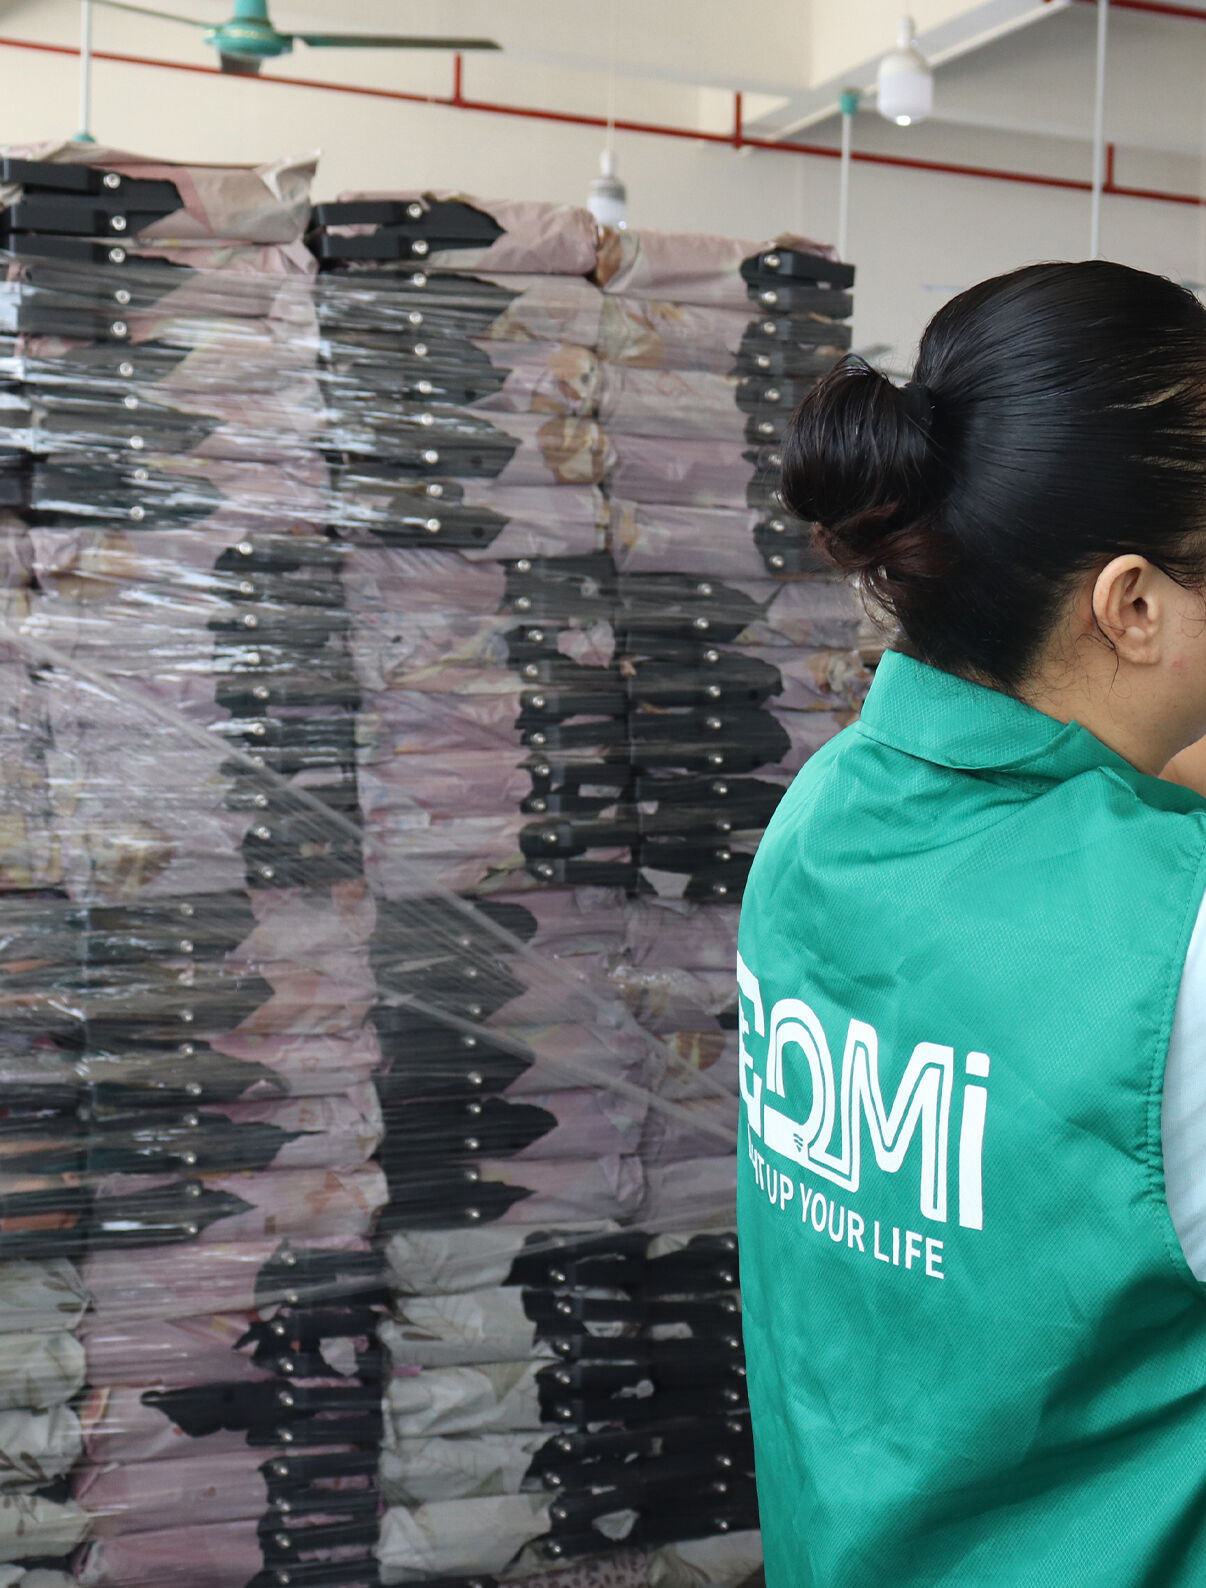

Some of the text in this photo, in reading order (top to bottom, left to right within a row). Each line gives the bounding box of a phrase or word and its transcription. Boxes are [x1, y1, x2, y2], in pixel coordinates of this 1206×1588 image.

[766, 1163, 795, 1211] UP
[799, 1182, 865, 1253] YOUR
[873, 1220, 945, 1280] LIFE
